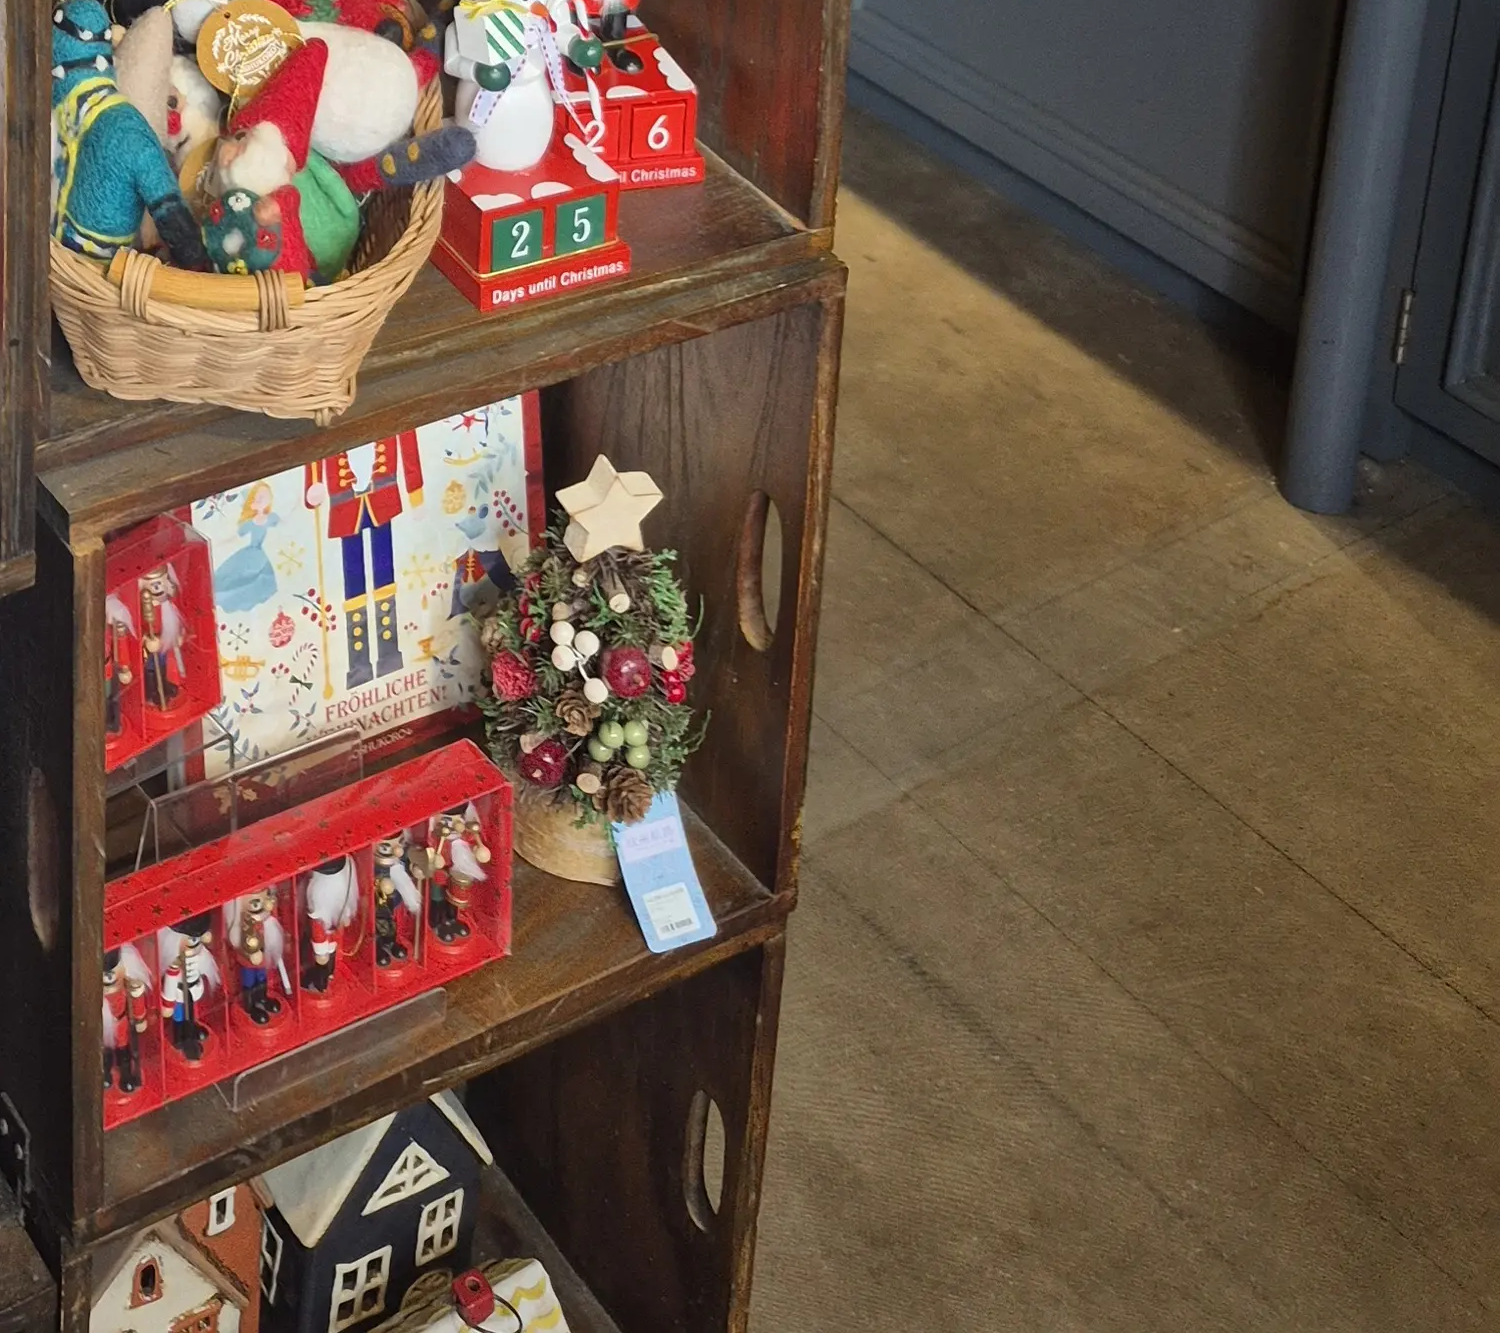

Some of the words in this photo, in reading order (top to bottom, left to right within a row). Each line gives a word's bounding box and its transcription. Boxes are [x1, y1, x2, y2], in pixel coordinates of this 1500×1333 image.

[648, 114, 669, 150] 6
[631, 164, 697, 183] Christmas
[510, 220, 531, 259] 2
[572, 208, 591, 243] 5
[492, 287, 525, 305] Days
[529, 274, 556, 296] until
[560, 260, 624, 287] Christmas
[325, 669, 428, 723] FRÖHLICHE
